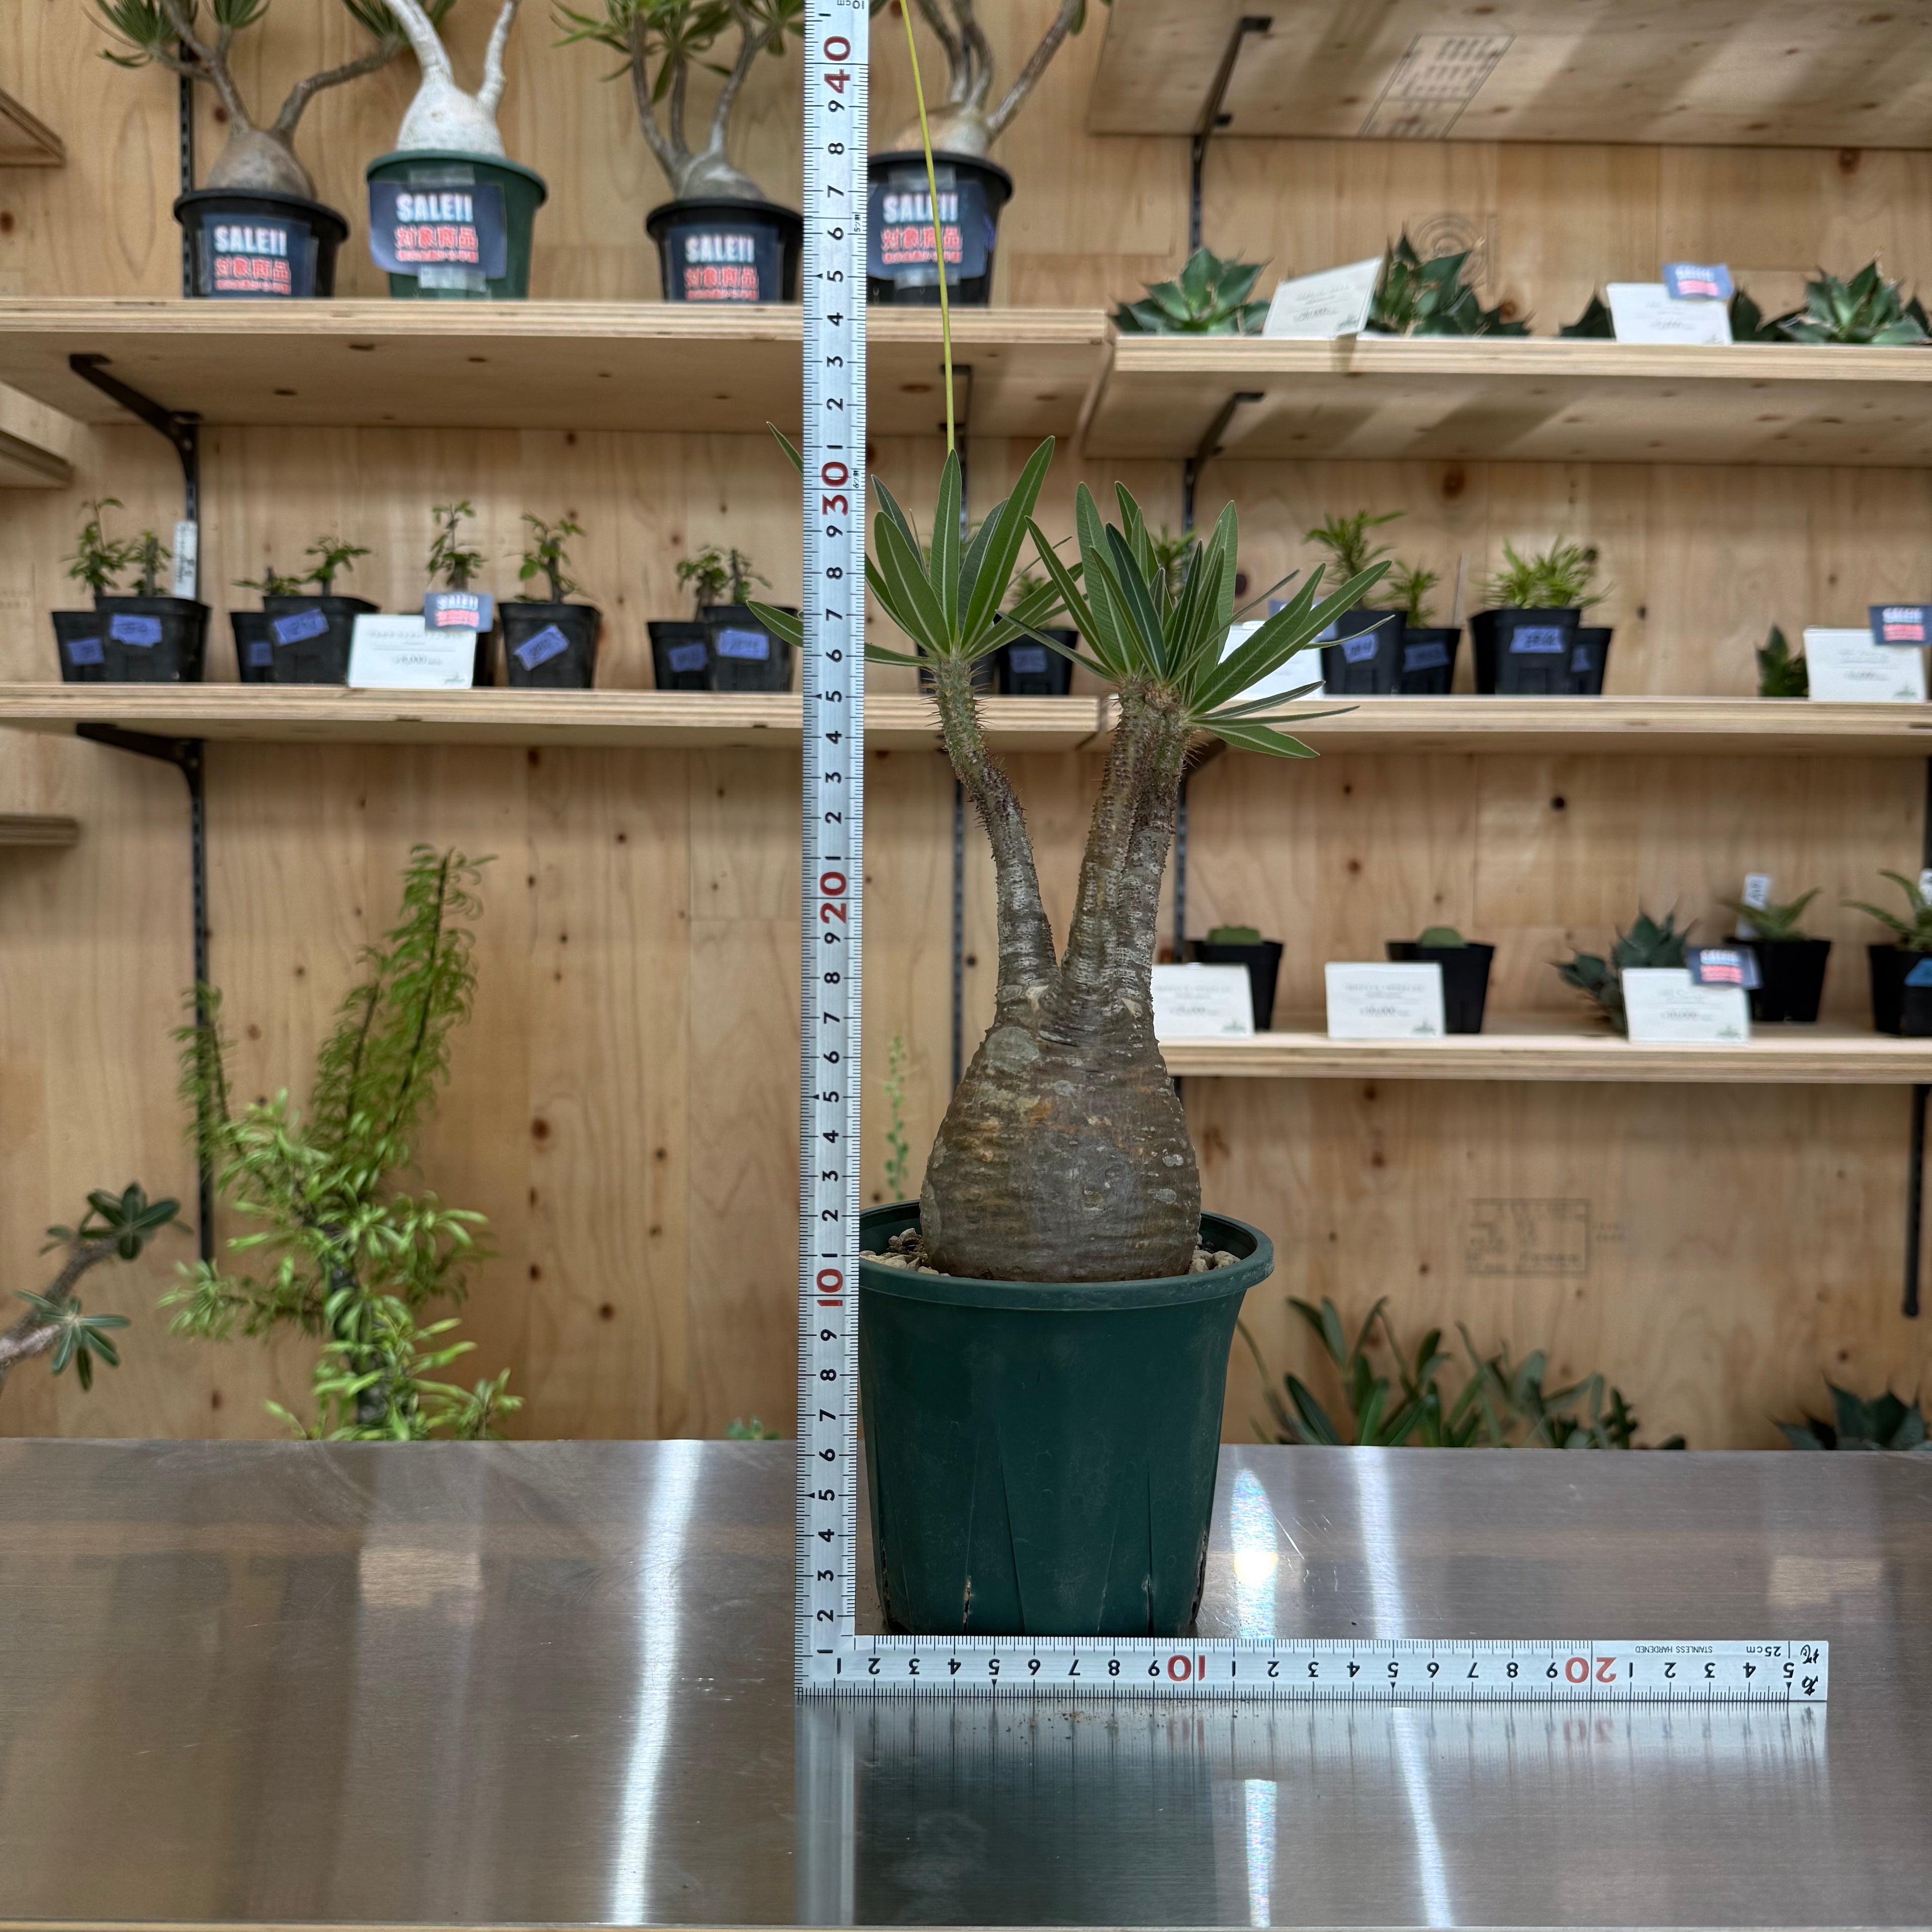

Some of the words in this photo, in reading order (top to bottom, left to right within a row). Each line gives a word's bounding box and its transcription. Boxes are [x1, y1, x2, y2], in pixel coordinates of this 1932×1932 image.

[824, 36, 850, 94] 40
[828, 100, 845, 112] 9
[828, 142, 844, 155] 8
[827, 185, 844, 197] 7
[396, 193, 473, 222] SALE!!
[214, 226, 287, 256] SALE!!
[827, 227, 844, 240] 6
[685, 234, 755, 263] SALE!!
[827, 270, 844, 282] 5
[827, 312, 844, 327] 4
[827, 356, 843, 368] 3
[826, 398, 843, 411] 2
[822, 461, 849, 516] 30
[826, 525, 843, 538] 9
[826, 567, 843, 580] 8
[826, 608, 843, 621] 7
[826, 649, 843, 663] 6
[826, 690, 842, 703] 5
[825, 730, 842, 745] 4
[825, 772, 842, 784] 3
[825, 812, 842, 825] 2
[820, 871, 847, 924] 20
[824, 932, 841, 944] 9
[824, 972, 841, 985] 8
[823, 1011, 840, 1024] 7
[823, 1051, 840, 1064] 6
[823, 1091, 840, 1103] 5
[823, 1130, 839, 1144] 4
[822, 1170, 839, 1182] 3
[822, 1209, 838, 1222] 2
[816, 1268, 843, 1307] 10
[820, 1329, 837, 1341] 9
[820, 1369, 837, 1382] 8
[819, 1408, 836, 1422] 7
[819, 1448, 836, 1462] 6
[818, 1489, 835, 1501] 5
[818, 1528, 835, 1543] 4
[817, 1569, 834, 1582] 3
[817, 1609, 834, 1623] 2
[1746, 1646, 1782, 1657] 25cm
[837, 1657, 842, 1674] 1
[868, 1657, 881, 1675] 2
[908, 1658, 921, 1675] 3
[947, 1658, 961, 1675] 4
[988, 1658, 1000, 1675] 5
[1027, 1659, 1041, 1675] 6
[1068, 1659, 1081, 1676] 7
[1108, 1659, 1120, 1676] 8
[1148, 1660, 1160, 1676] 9
[1168, 1655, 1205, 1681] 10
[1232, 1660, 1236, 1677] 1
[1267, 1661, 1279, 1677] 2
[1308, 1661, 1319, 1677] 3
[1346, 1661, 1360, 1678] 4
[1388, 1662, 1399, 1678] 5
[1426, 1662, 1439, 1678] 6
[1467, 1662, 1479, 1678] 7
[1506, 1662, 1518, 1678] 8
[1546, 1662, 1558, 1678] 9
[1565, 1657, 1617, 1683] 20
[1629, 1662, 1633, 1678] 1
[1664, 1662, 1676, 1678] 2
[1704, 1662, 1716, 1678] 3
[1743, 1662, 1756, 1678] 4
[1783, 1662, 1795, 1678] 5
